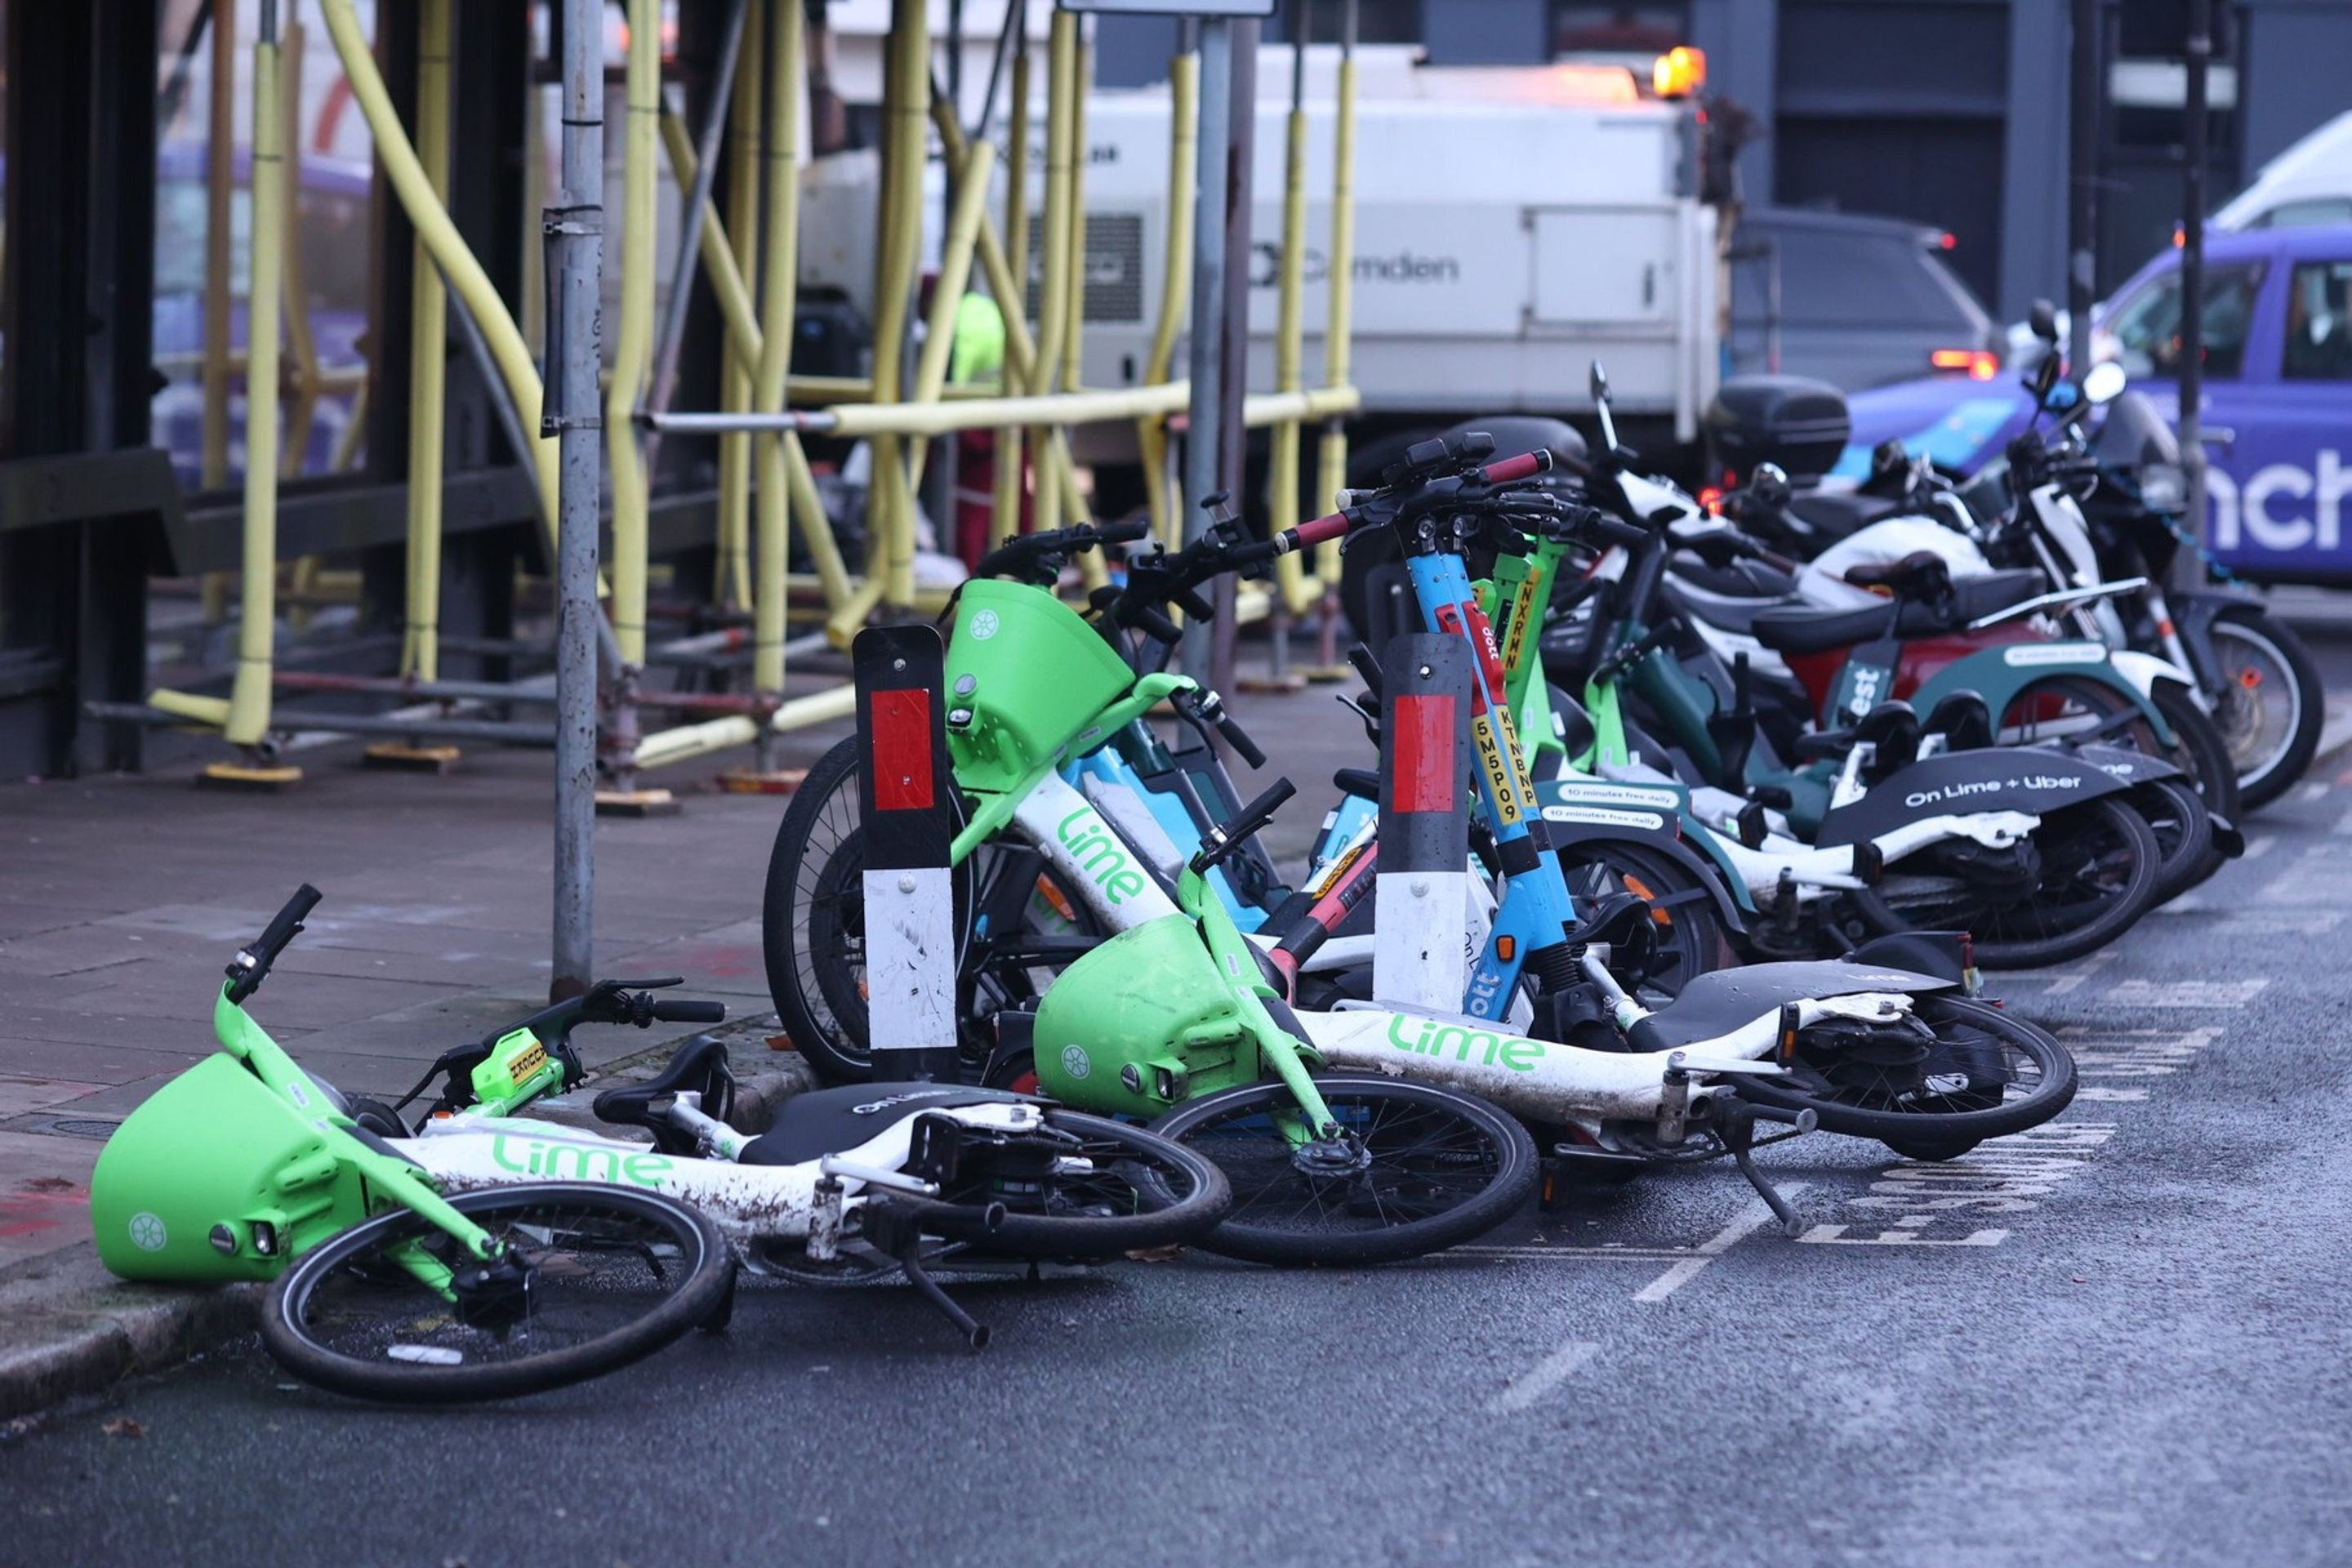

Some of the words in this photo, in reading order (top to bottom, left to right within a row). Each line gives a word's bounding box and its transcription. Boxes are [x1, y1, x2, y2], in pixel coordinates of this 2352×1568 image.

[1298, 247, 1460, 283] Cmden
[1481, 626, 1499, 661] dott
[1477, 722, 1516, 819] 5M5P09
[1904, 791, 1941, 808] On
[1943, 778, 2002, 799] Lime
[2006, 777, 2020, 789] +
[2023, 775, 2082, 791] Uber
[1583, 790, 1624, 799] minutes
[1058, 806, 1144, 905] Lime
[1388, 1013, 1546, 1072] Lime
[492, 1132, 674, 1187] Lime
